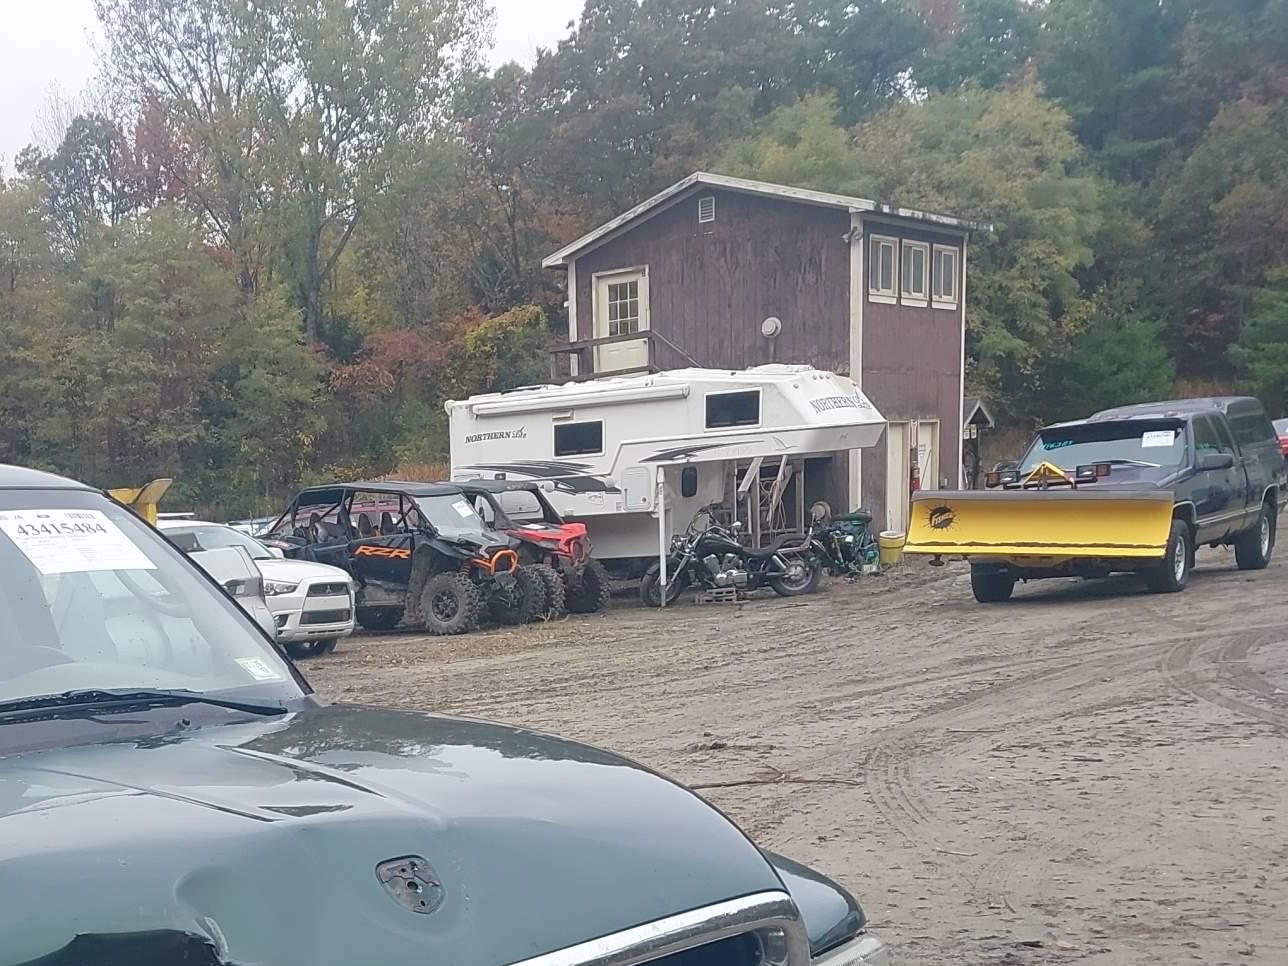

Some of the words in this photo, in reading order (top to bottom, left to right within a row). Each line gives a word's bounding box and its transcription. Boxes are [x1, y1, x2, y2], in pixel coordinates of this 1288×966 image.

[809, 396, 857, 414] NORTHERN
[465, 431, 511, 443] NORTHERN
[17, 523, 107, 536] 43415484
[355, 546, 409, 559] RZR
